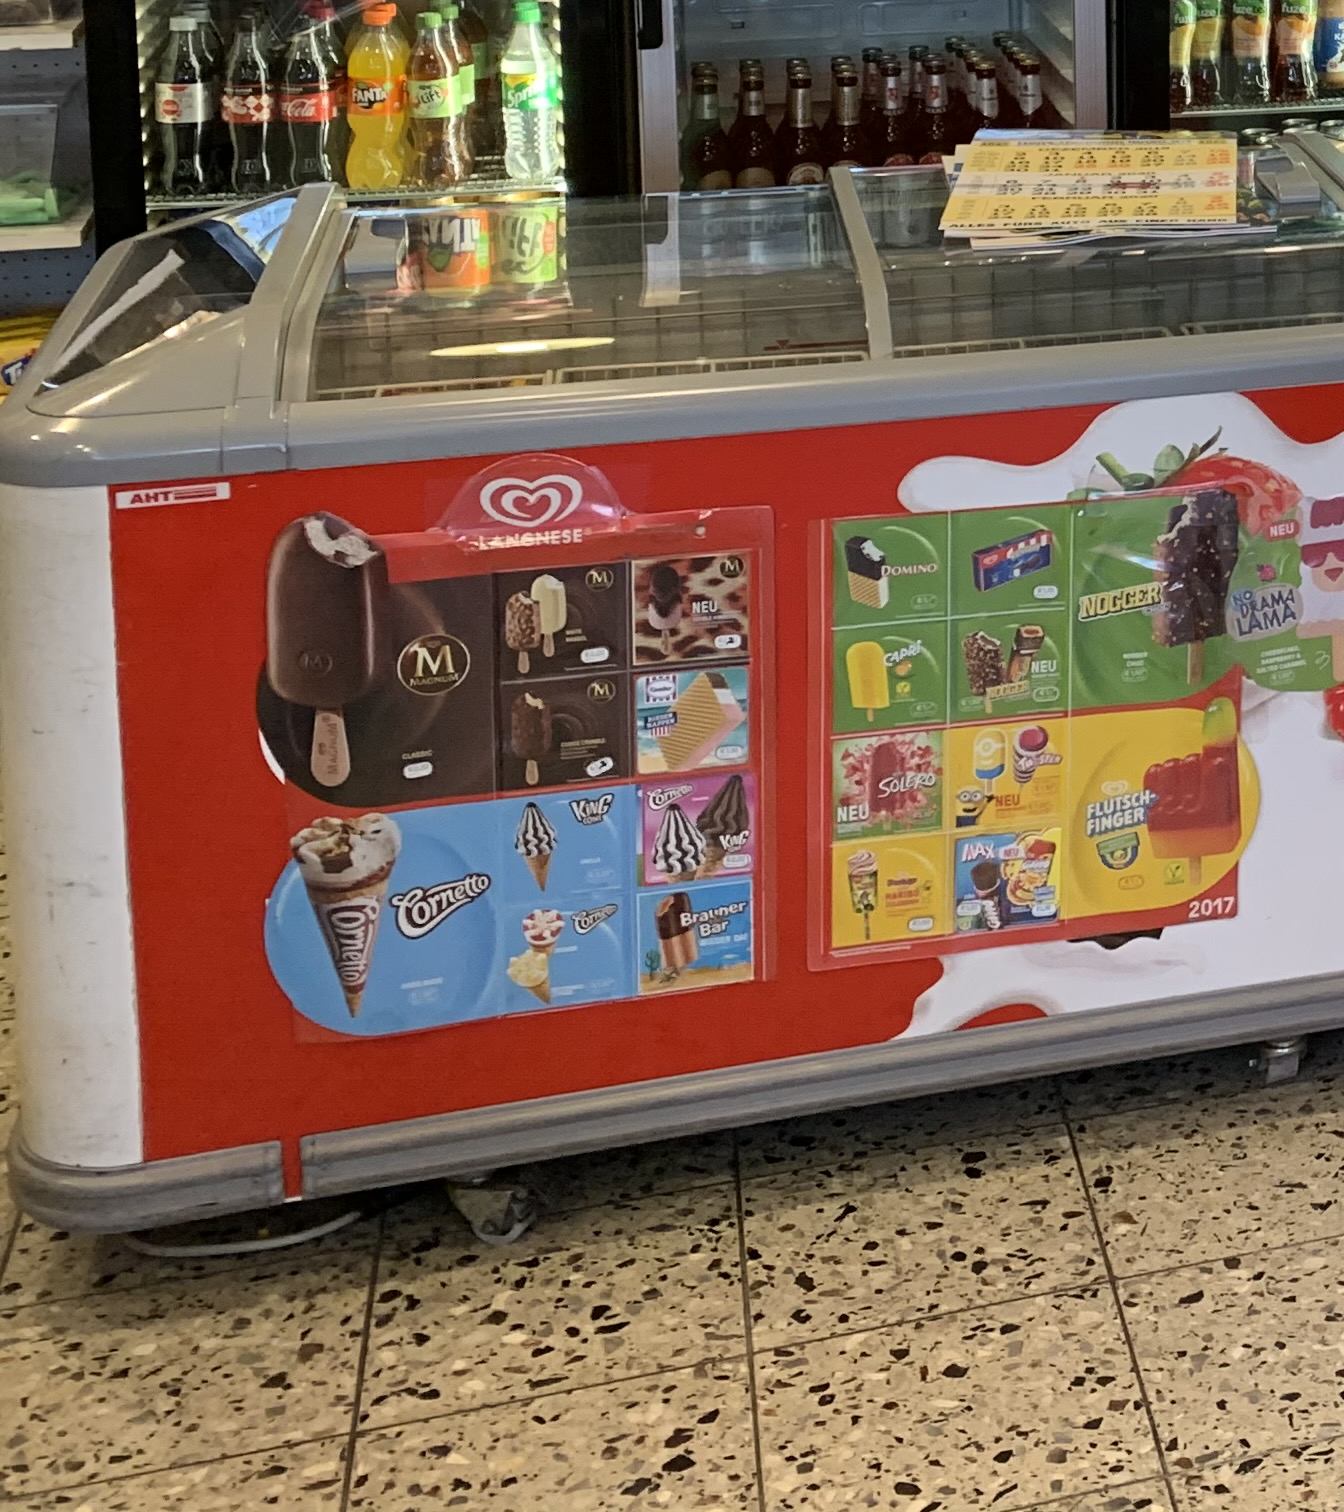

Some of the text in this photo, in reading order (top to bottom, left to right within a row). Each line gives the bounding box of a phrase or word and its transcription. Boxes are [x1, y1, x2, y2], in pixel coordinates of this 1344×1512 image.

[352, 88, 388, 103] FANTA
[129, 490, 171, 506] AHT
[475, 529, 583, 550] LANGNESE
[1269, 523, 1295, 538] NEU
[881, 564, 938, 577] DOMINO
[692, 601, 718, 614] NEU
[1080, 585, 1162, 618] NOGGER
[1233, 591, 1254, 607] NO
[1240, 589, 1296, 617] DRAMA
[1236, 607, 1297, 637] LAMA
[1031, 660, 1057, 673] NEU
[409, 672, 459, 687] MAGNUM
[878, 773, 936, 798] SOLERO
[571, 793, 614, 819] KING
[646, 785, 694, 811] Cornetto
[995, 794, 1021, 807] NEU
[1087, 791, 1157, 819] FLUTSCH-
[837, 806, 870, 823] NEU
[1087, 809, 1146, 836] FINGER
[719, 831, 750, 850] KING
[962, 843, 995, 862] MAX
[390, 873, 491, 939] Cornetto
[680, 901, 747, 927] Brauner
[1188, 897, 1236, 920] 2017
[571, 904, 618, 935] Cornetto
[699, 919, 730, 937] Bar
[329, 896, 380, 986] Cornetto
